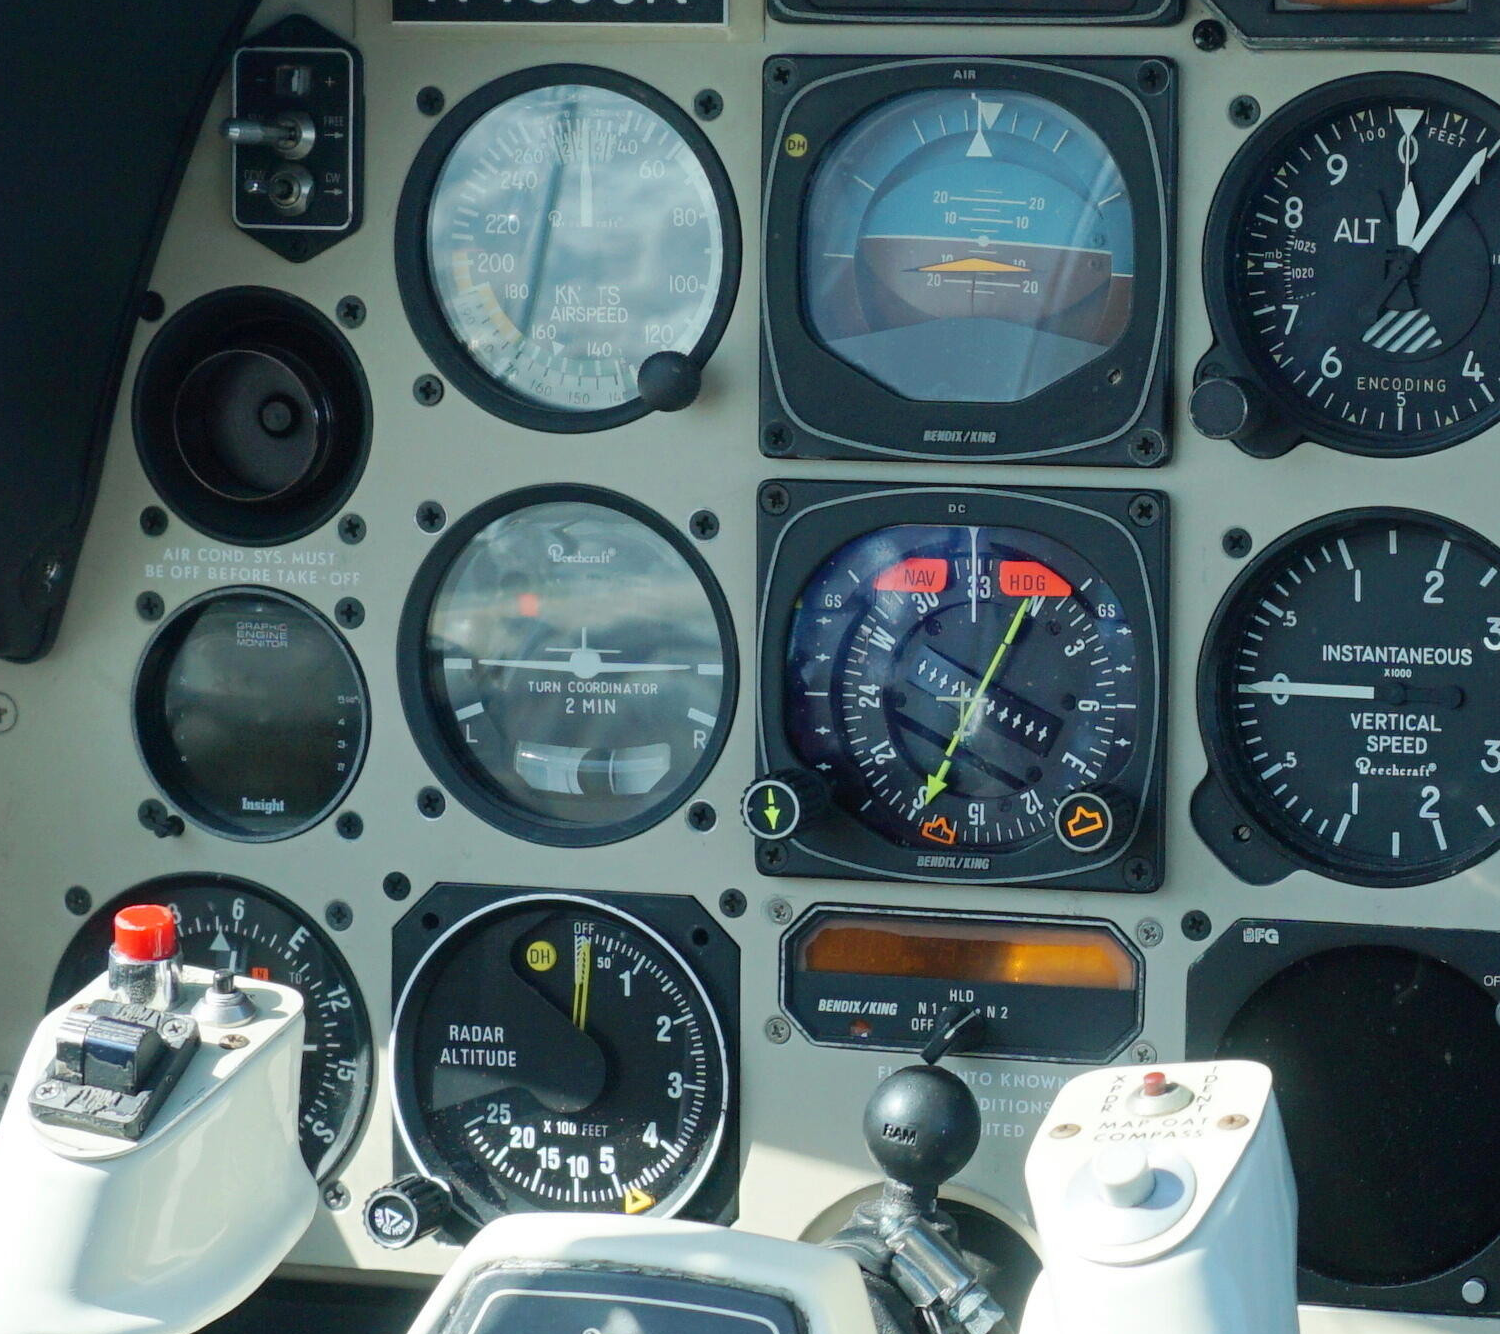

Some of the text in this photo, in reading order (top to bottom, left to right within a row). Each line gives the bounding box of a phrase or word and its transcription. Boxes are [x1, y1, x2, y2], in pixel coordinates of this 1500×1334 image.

[954, 70, 975, 79] AIR
[1334, 218, 1380, 243] ALT
[550, 306, 628, 323] AIRSPEED
[924, 431, 996, 443] BENDIX/KING
[164, 548, 190, 561] AIR
[292, 552, 334, 565] MUST
[145, 565, 163, 577] BE
[170, 565, 199, 579] OFF
[207, 566, 271, 582] BEFORE
[905, 569, 936, 587] NAV
[1010, 575, 1045, 591] HDG
[1323, 645, 1472, 665] INSTANTANEOUS
[528, 681, 657, 694] TURN COORDINATOR
[566, 698, 615, 714] 2 MIN
[1351, 713, 1442, 731] VERTICAL
[1367, 735, 1427, 754] SPEED
[242, 797, 284, 814] Insight
[450, 1025, 503, 1043] RADAR
[441, 1048, 516, 1067] ALTITUDE
